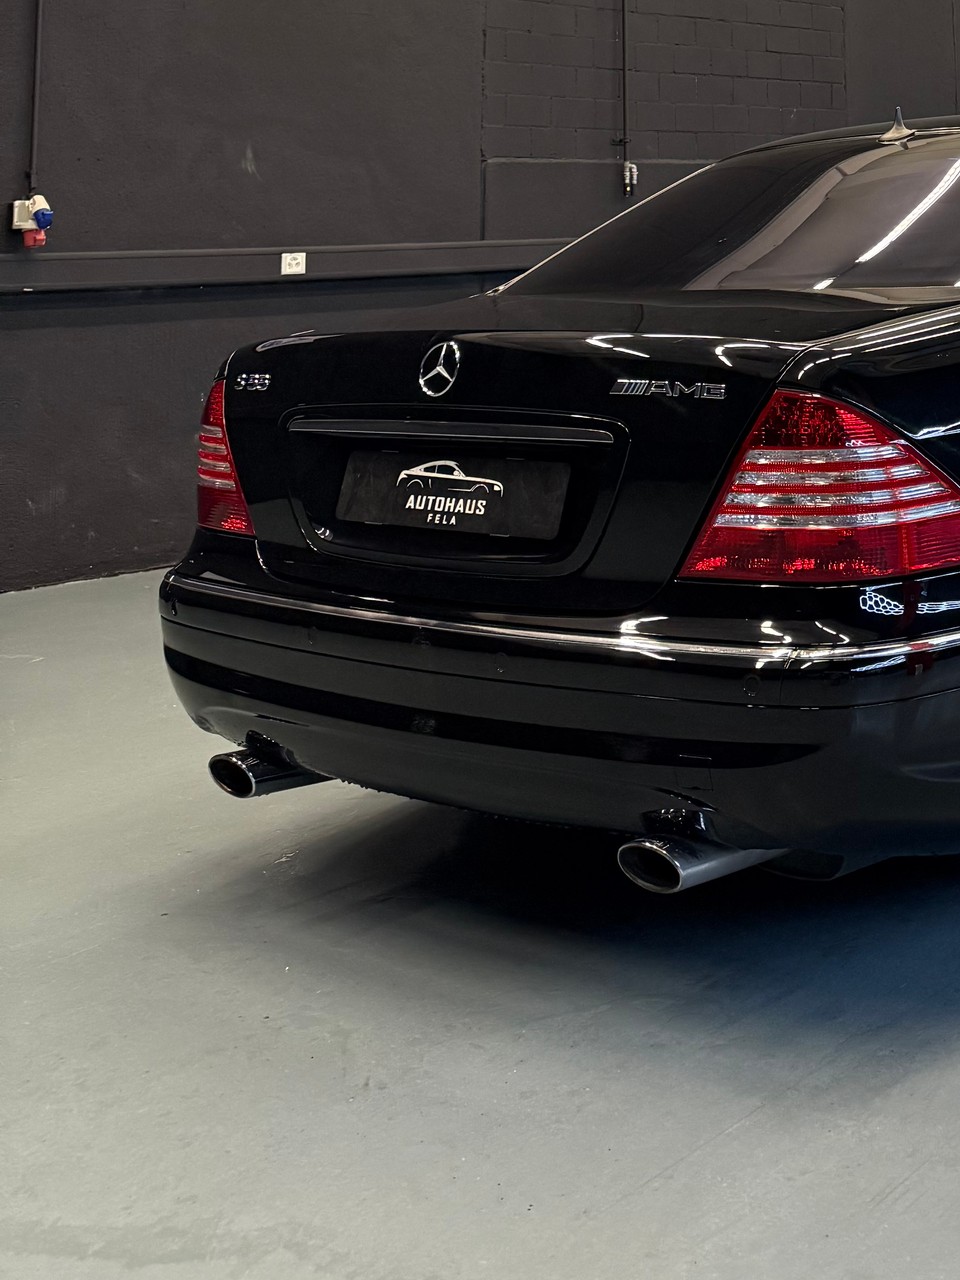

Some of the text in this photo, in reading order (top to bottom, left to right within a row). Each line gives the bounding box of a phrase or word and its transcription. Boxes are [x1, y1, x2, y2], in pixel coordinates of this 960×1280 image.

[234, 373, 272, 391] S55
[644, 380, 727, 400] AMG
[405, 494, 487, 515] AUTOHAUS
[426, 513, 457, 526] FELA
